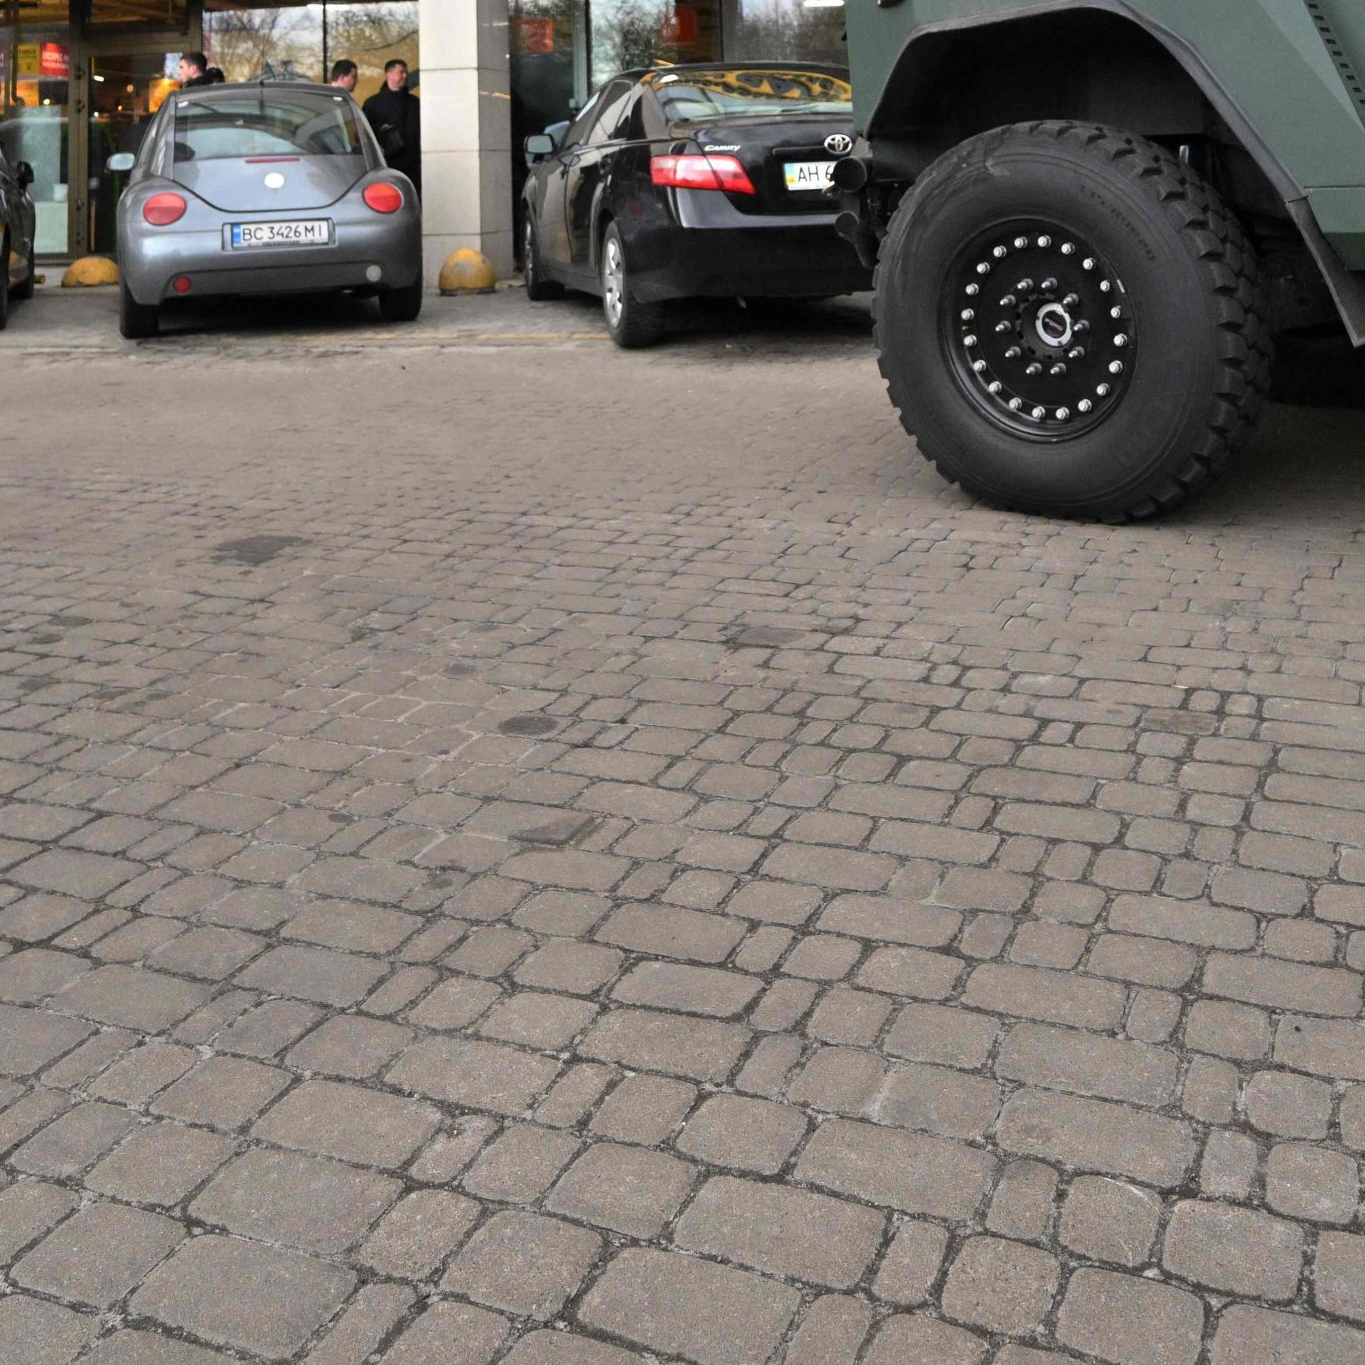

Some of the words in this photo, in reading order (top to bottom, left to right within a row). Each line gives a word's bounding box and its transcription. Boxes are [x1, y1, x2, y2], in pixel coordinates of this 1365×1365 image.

[798, 165, 819, 182] AH
[242, 226, 264, 242] BC
[267, 225, 302, 240] 3426
[304, 224, 322, 238] MI
